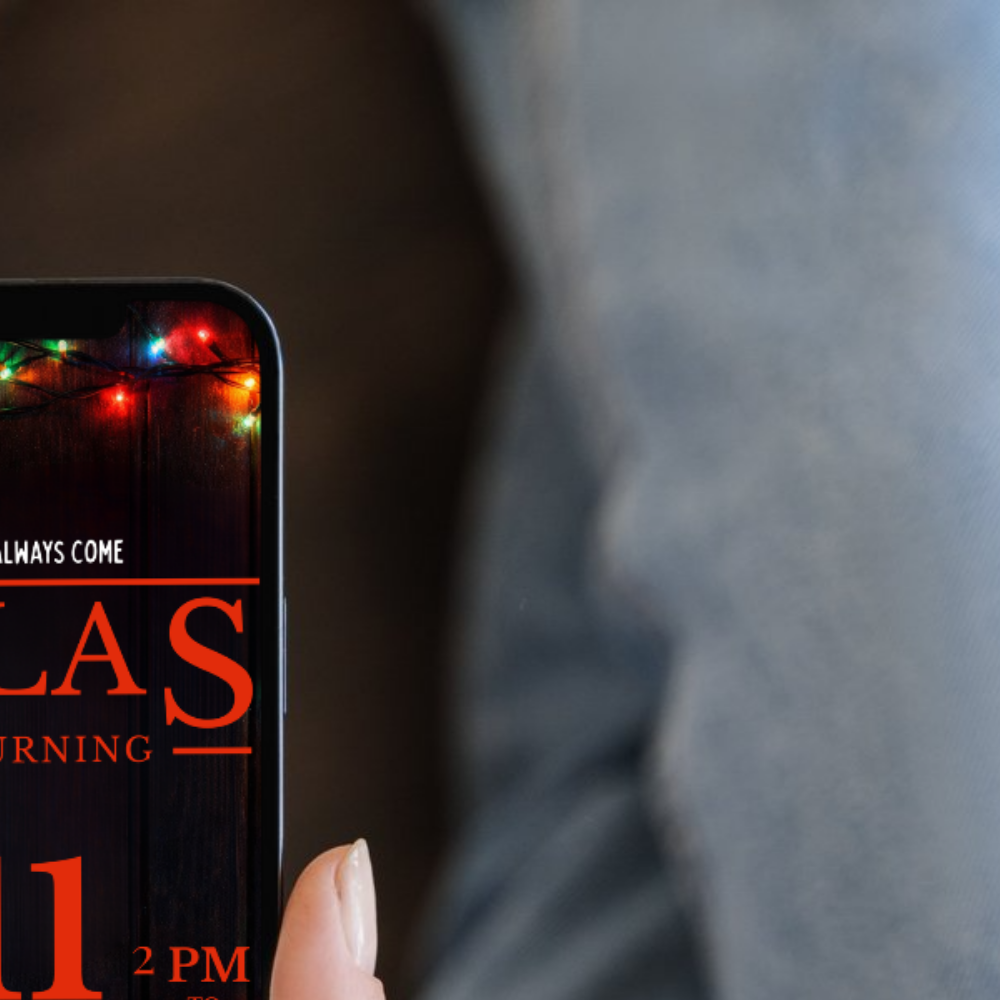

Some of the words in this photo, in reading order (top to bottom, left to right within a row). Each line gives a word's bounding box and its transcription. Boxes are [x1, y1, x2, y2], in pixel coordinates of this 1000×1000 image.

[71, 539, 124, 564] COME
[133, 946, 155, 975] 2
[168, 946, 250, 983] PM
